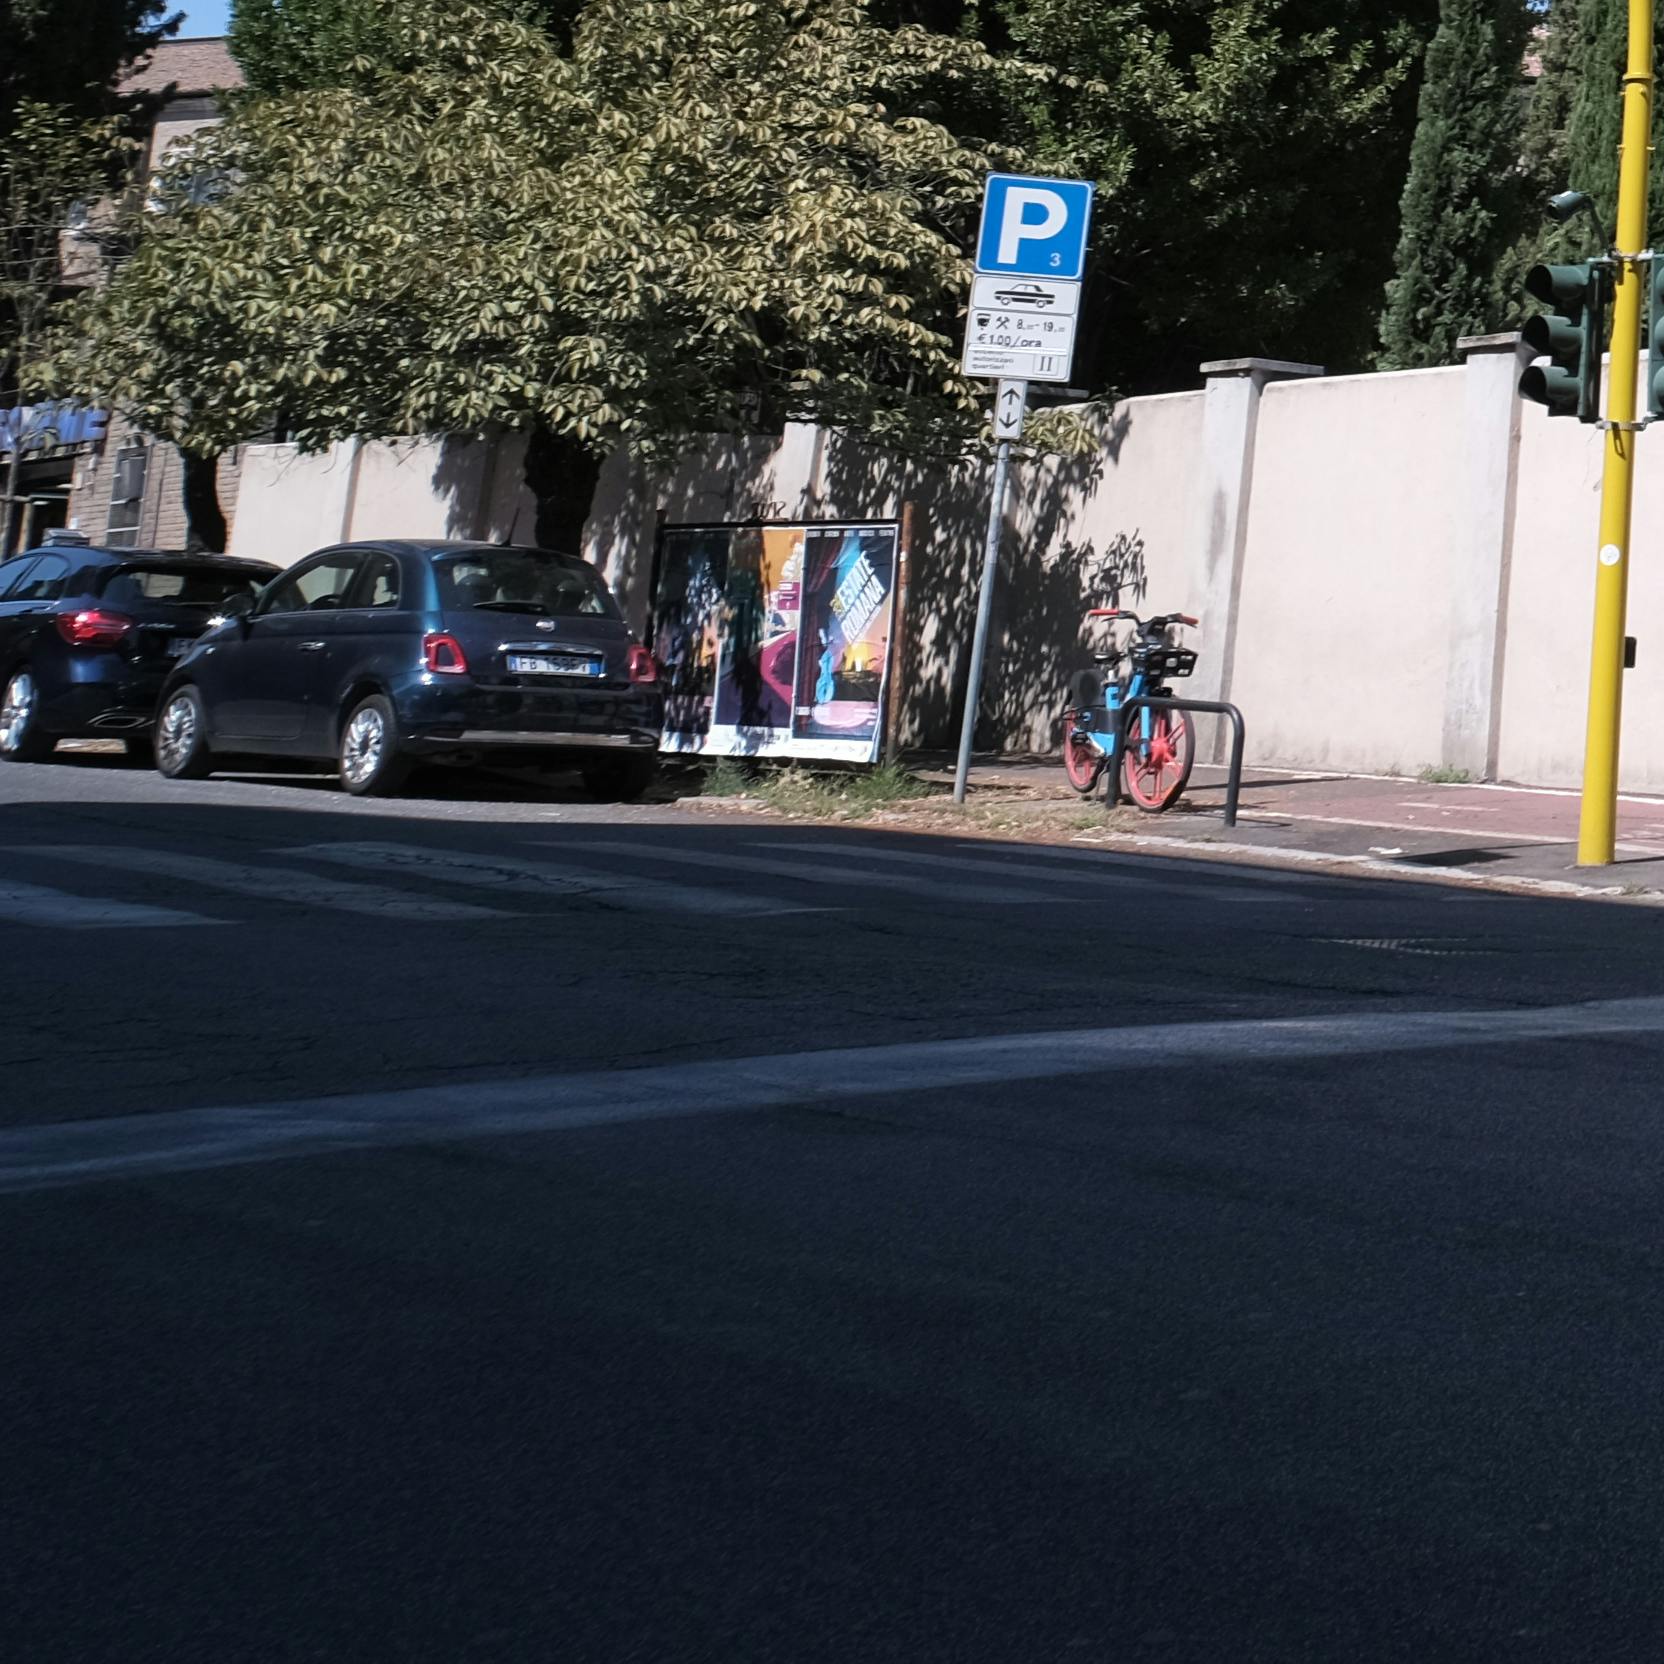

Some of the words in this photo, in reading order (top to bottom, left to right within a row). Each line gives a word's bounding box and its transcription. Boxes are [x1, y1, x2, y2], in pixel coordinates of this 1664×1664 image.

[997, 186, 1068, 265] P
[1049, 252, 1061, 267] 3
[837, 550, 876, 615] ESTATE
[841, 574, 886, 644] ROMANA
